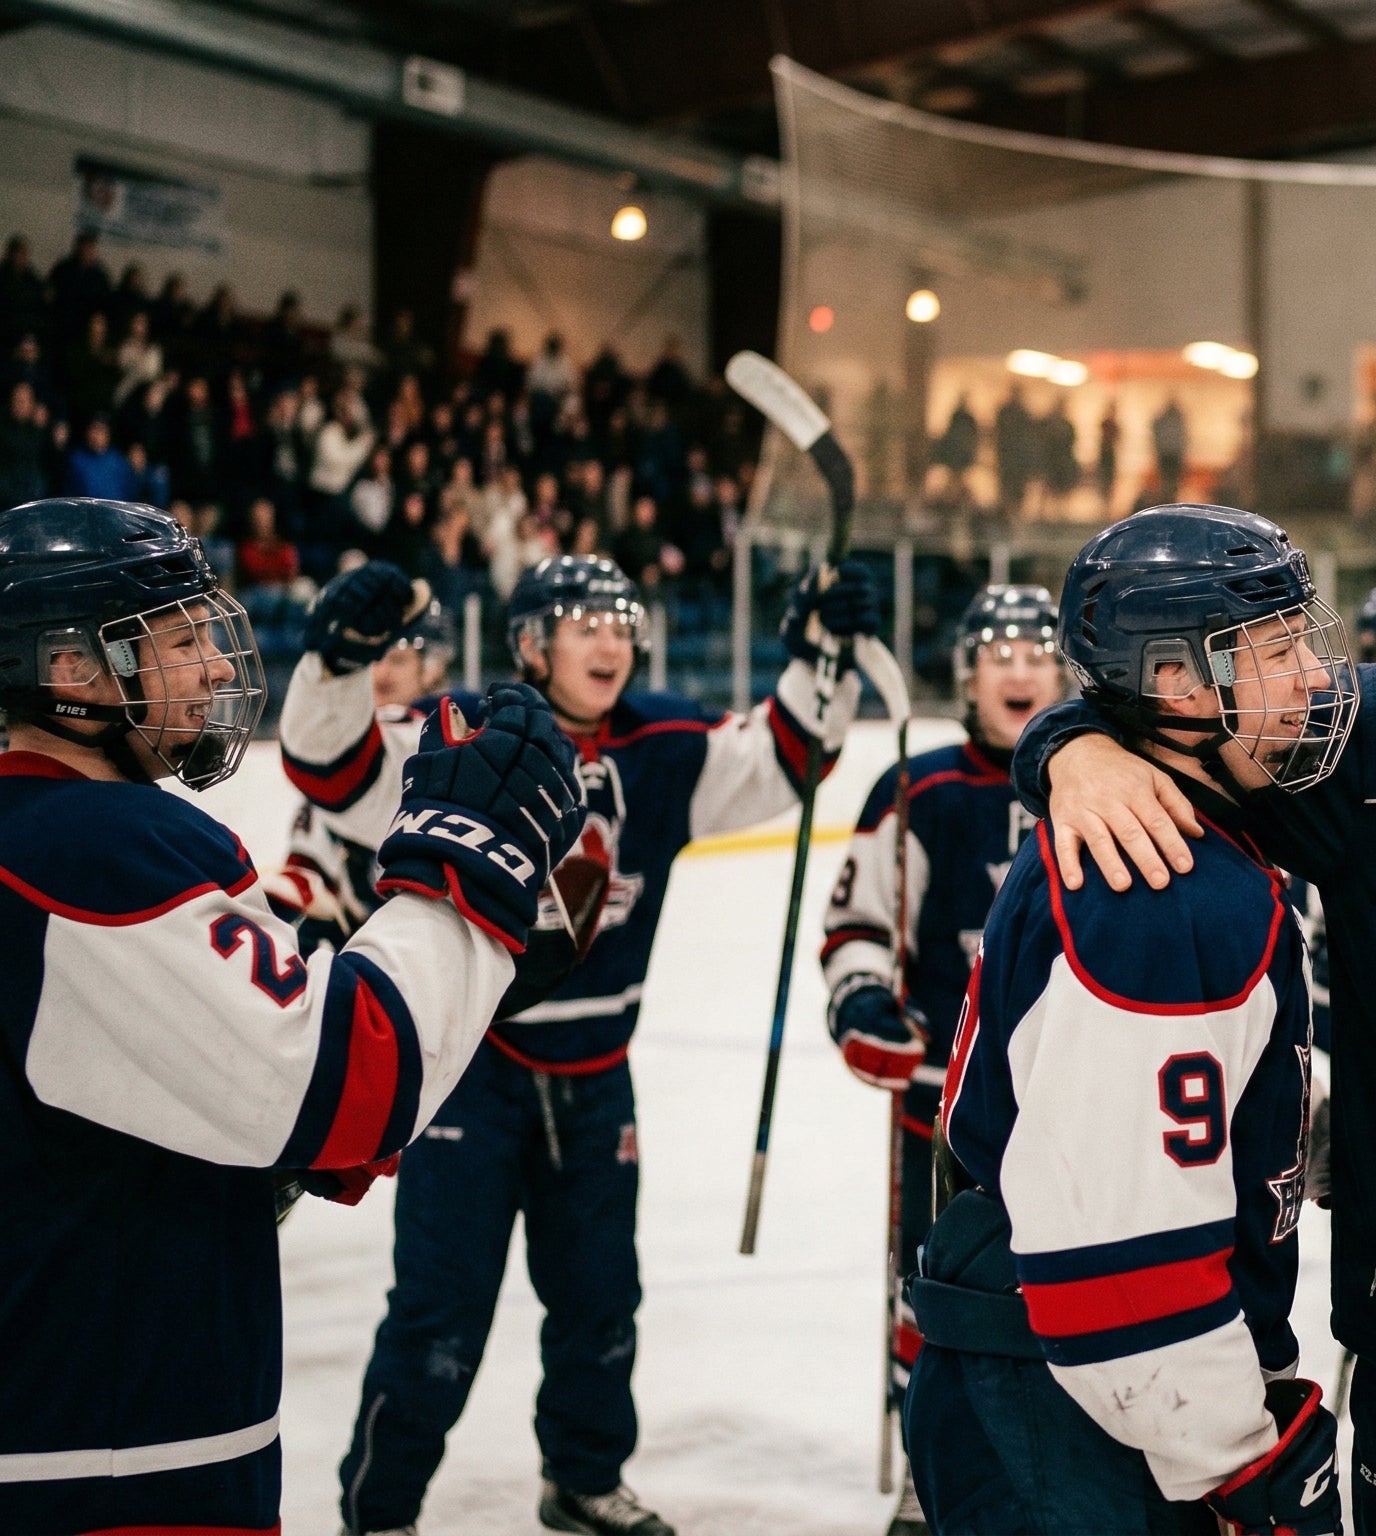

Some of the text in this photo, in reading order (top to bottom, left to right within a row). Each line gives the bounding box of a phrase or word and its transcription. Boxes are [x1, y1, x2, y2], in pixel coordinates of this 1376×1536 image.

[386, 808, 536, 888] CCM
[209, 912, 308, 1009] 2
[1157, 1050, 1228, 1168] 9
